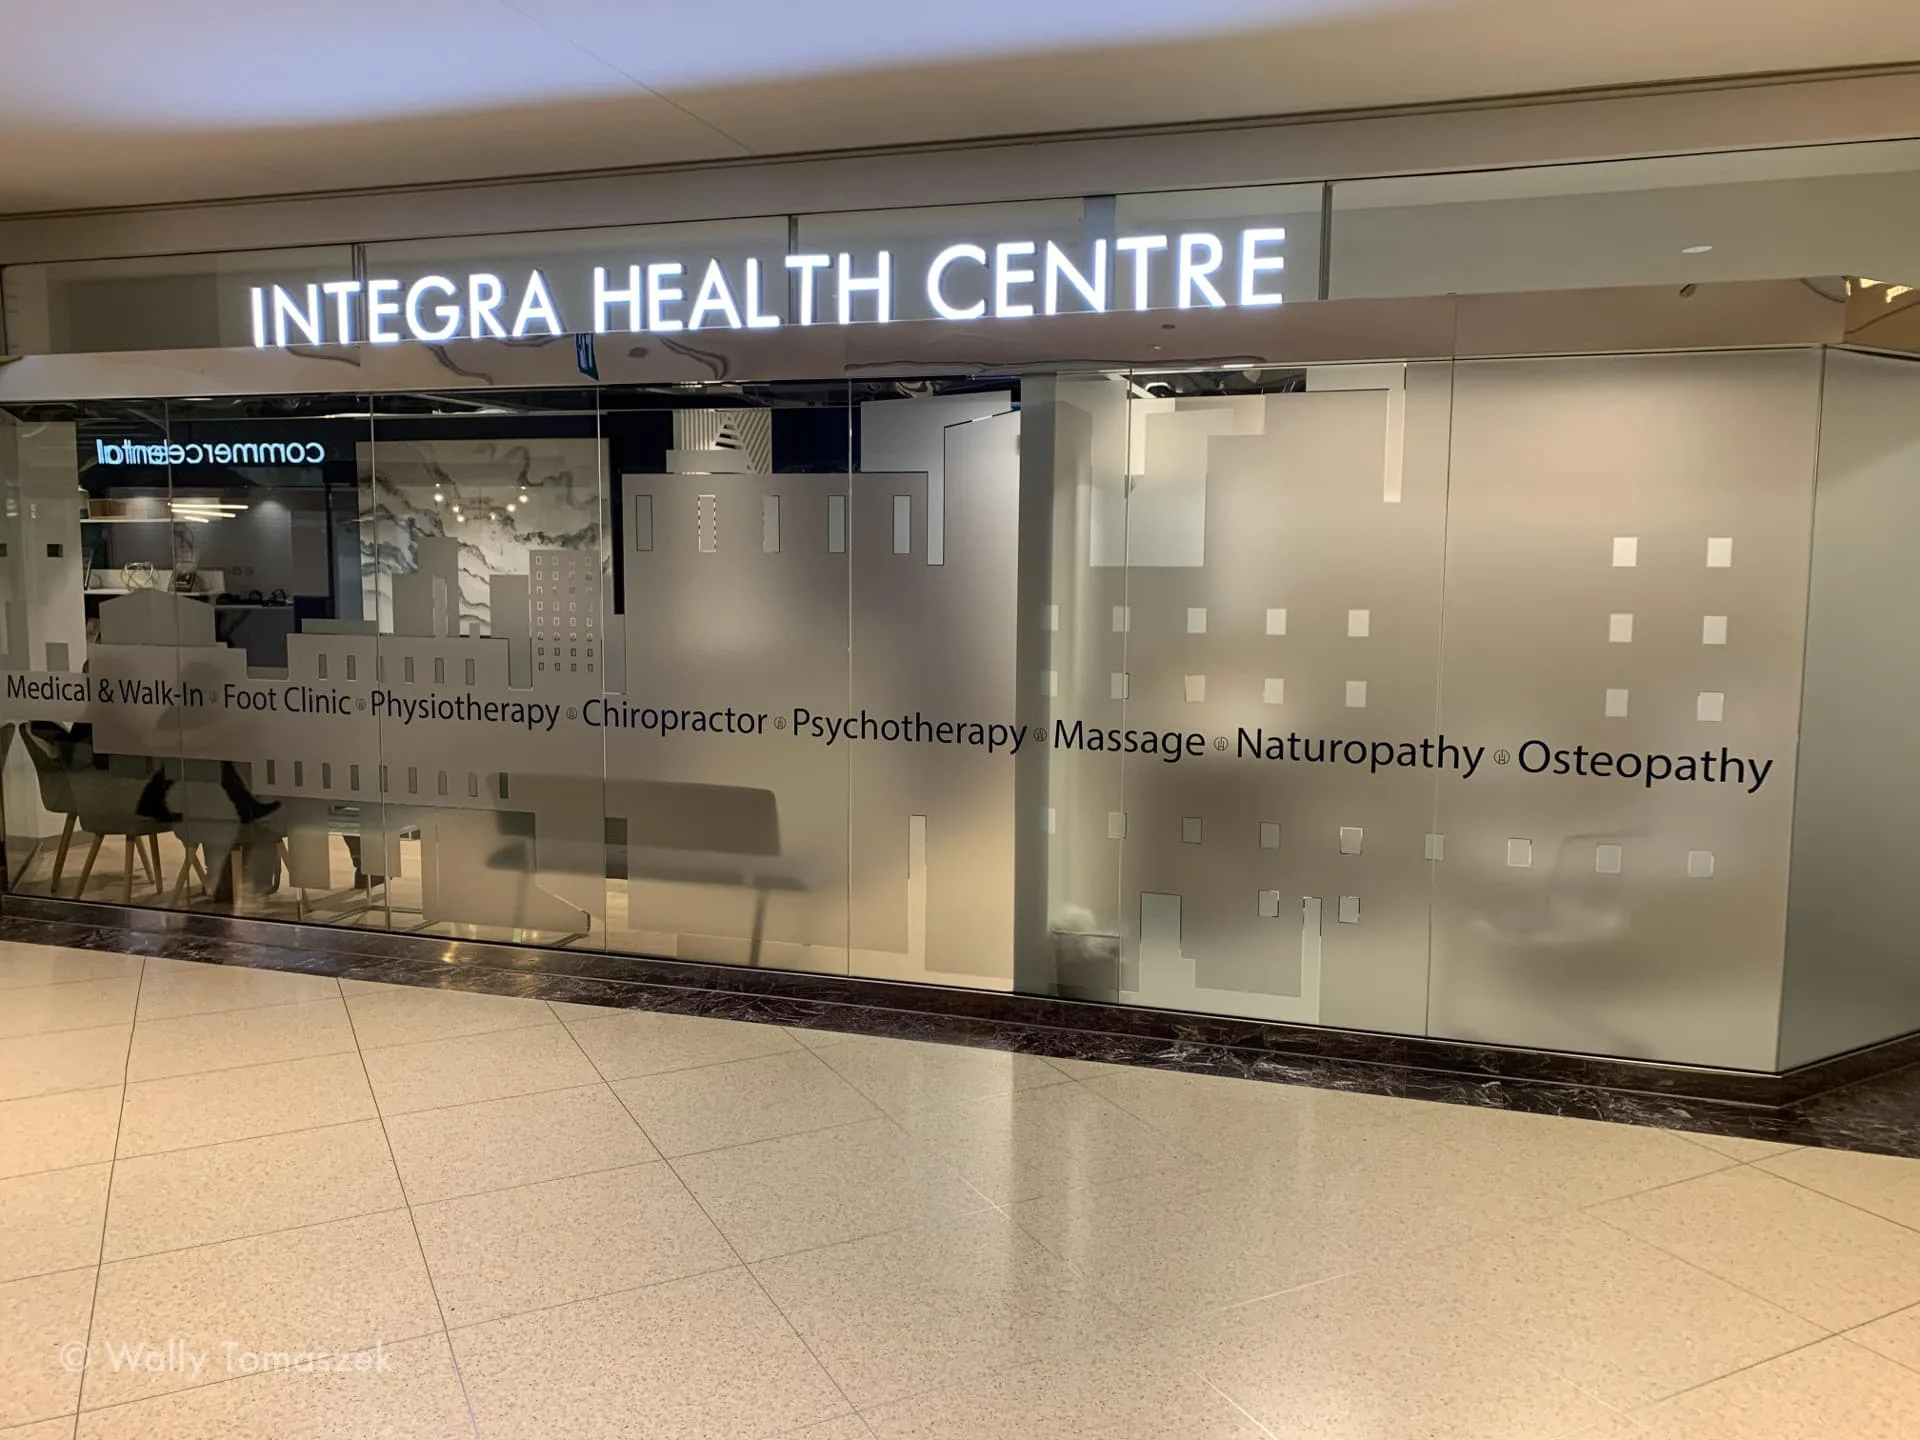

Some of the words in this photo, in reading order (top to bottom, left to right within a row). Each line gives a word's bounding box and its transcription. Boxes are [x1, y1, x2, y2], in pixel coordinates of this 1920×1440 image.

[251, 270, 562, 348] INTEGRA
[593, 250, 893, 333] HEALTH
[926, 227, 1286, 321] CENTRE
[7, 675, 91, 702] Medical
[98, 679, 113, 703] &
[118, 680, 204, 707] Walk-In
[223, 684, 277, 712] Foot
[284, 687, 351, 715] Clinic
[371, 690, 560, 731] Physiotherapy
[583, 699, 768, 737] Chiropractor
[793, 708, 1027, 753] Psychotherapy
[1054, 719, 1206, 763] Massage
[1236, 727, 1485, 779] Naturopathy
[1518, 739, 1773, 794] Osteopathy
